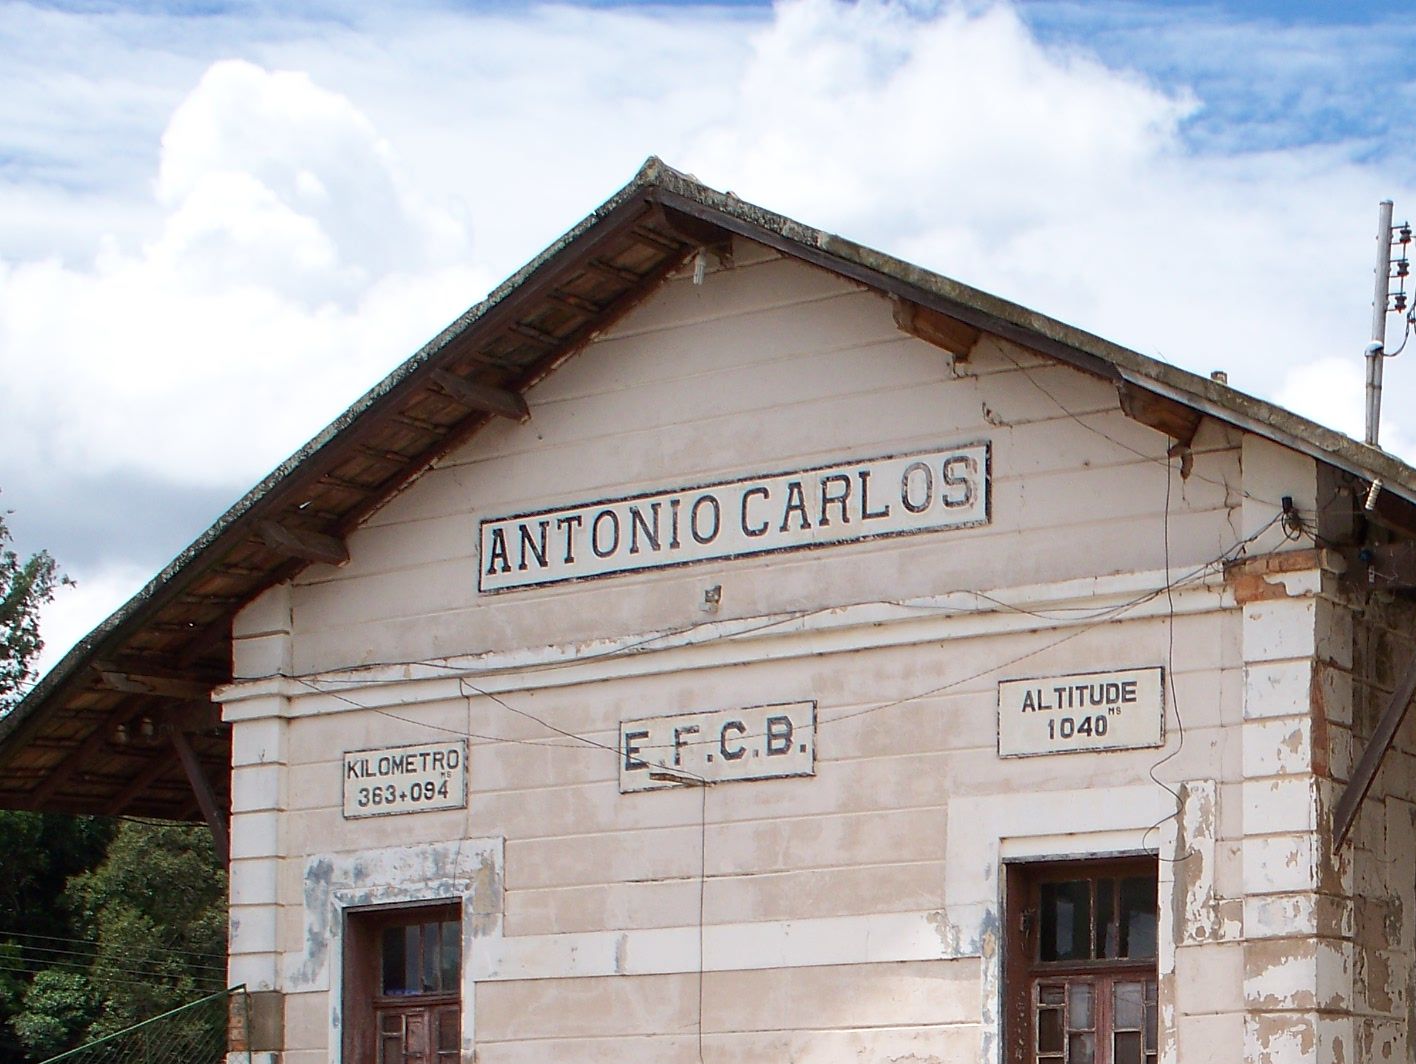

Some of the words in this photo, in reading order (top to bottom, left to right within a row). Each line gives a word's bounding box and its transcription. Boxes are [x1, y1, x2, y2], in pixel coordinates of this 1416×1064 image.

[486, 494, 720, 575] ANTONIO
[741, 455, 978, 537] CARLOS
[1022, 681, 1138, 713] ALTITUDE
[1048, 715, 1108, 740] 1040
[347, 749, 460, 779] KILOMETRO
[358, 780, 449, 807] 363+094
